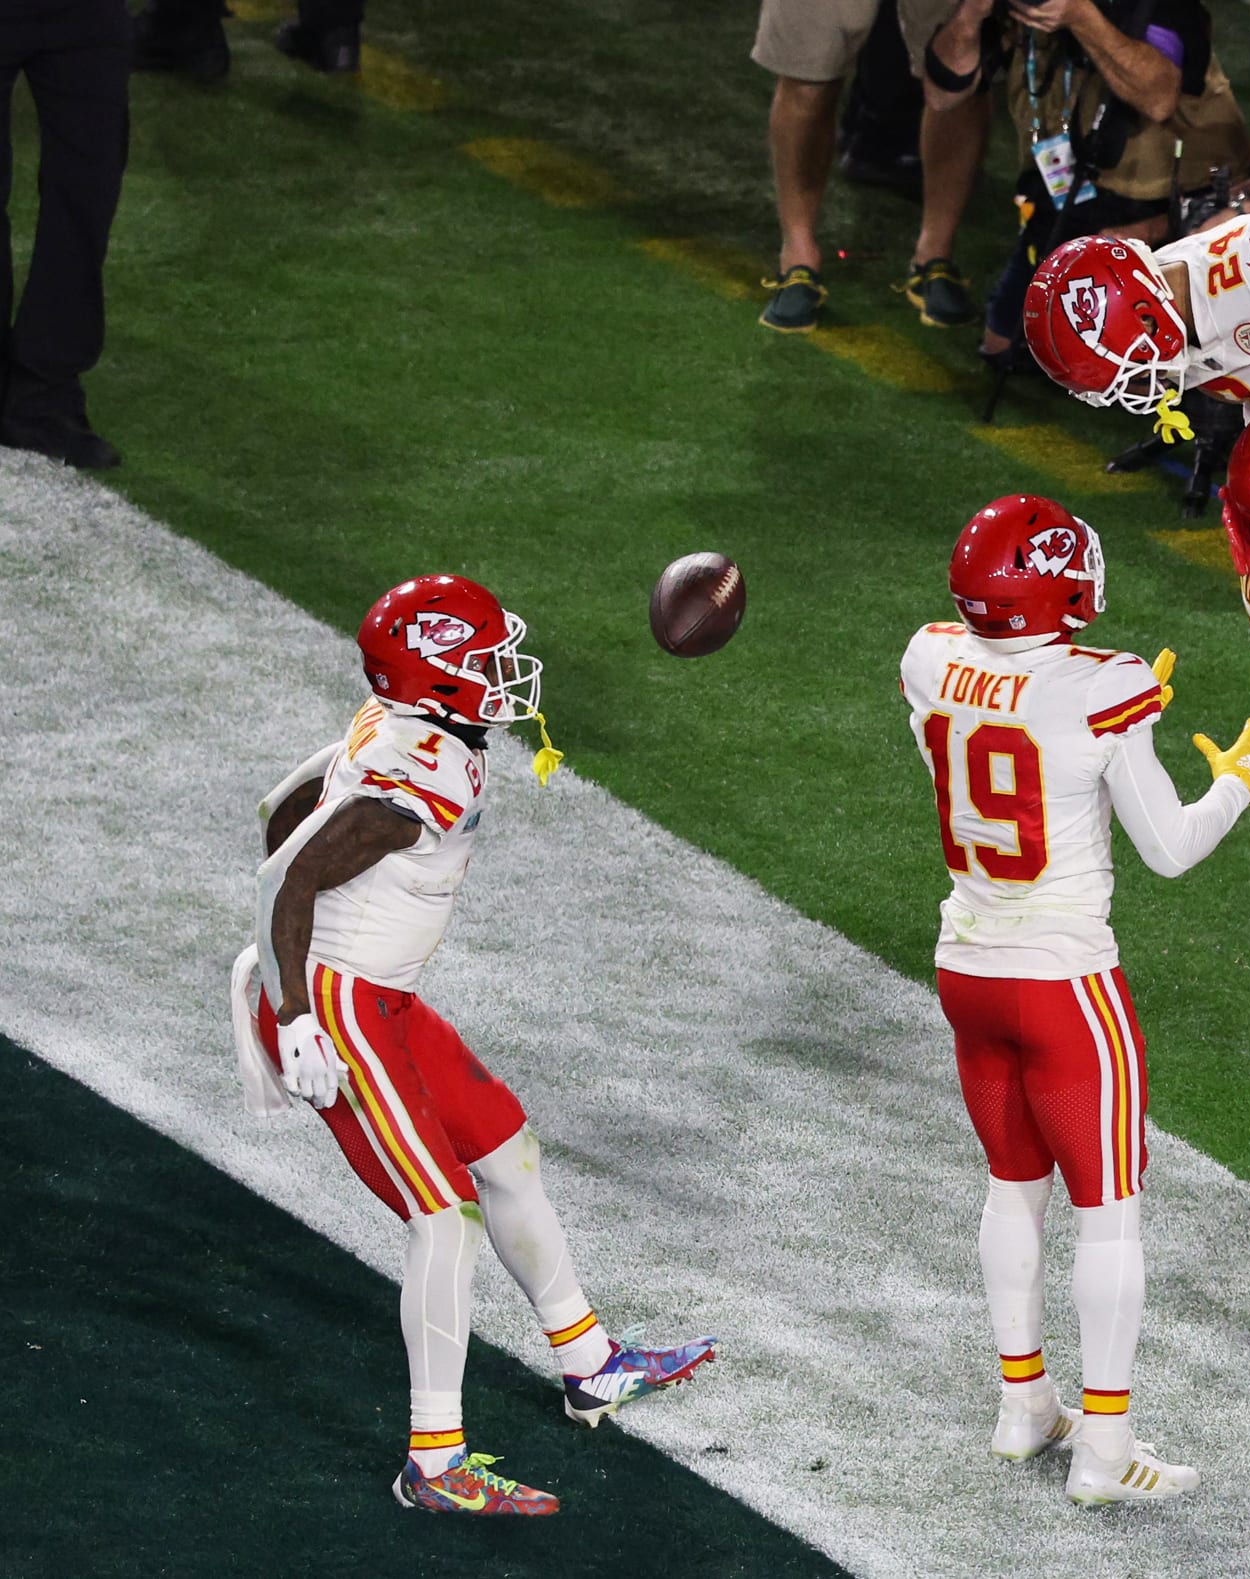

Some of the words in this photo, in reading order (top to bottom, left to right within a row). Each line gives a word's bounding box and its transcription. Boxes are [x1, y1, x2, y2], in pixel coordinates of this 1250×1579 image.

[1207, 224, 1247, 299] 24
[938, 661, 1031, 714] TONEY
[415, 729, 446, 759] 1
[922, 710, 1050, 885] 19
[578, 1371, 647, 1403] NIKE
